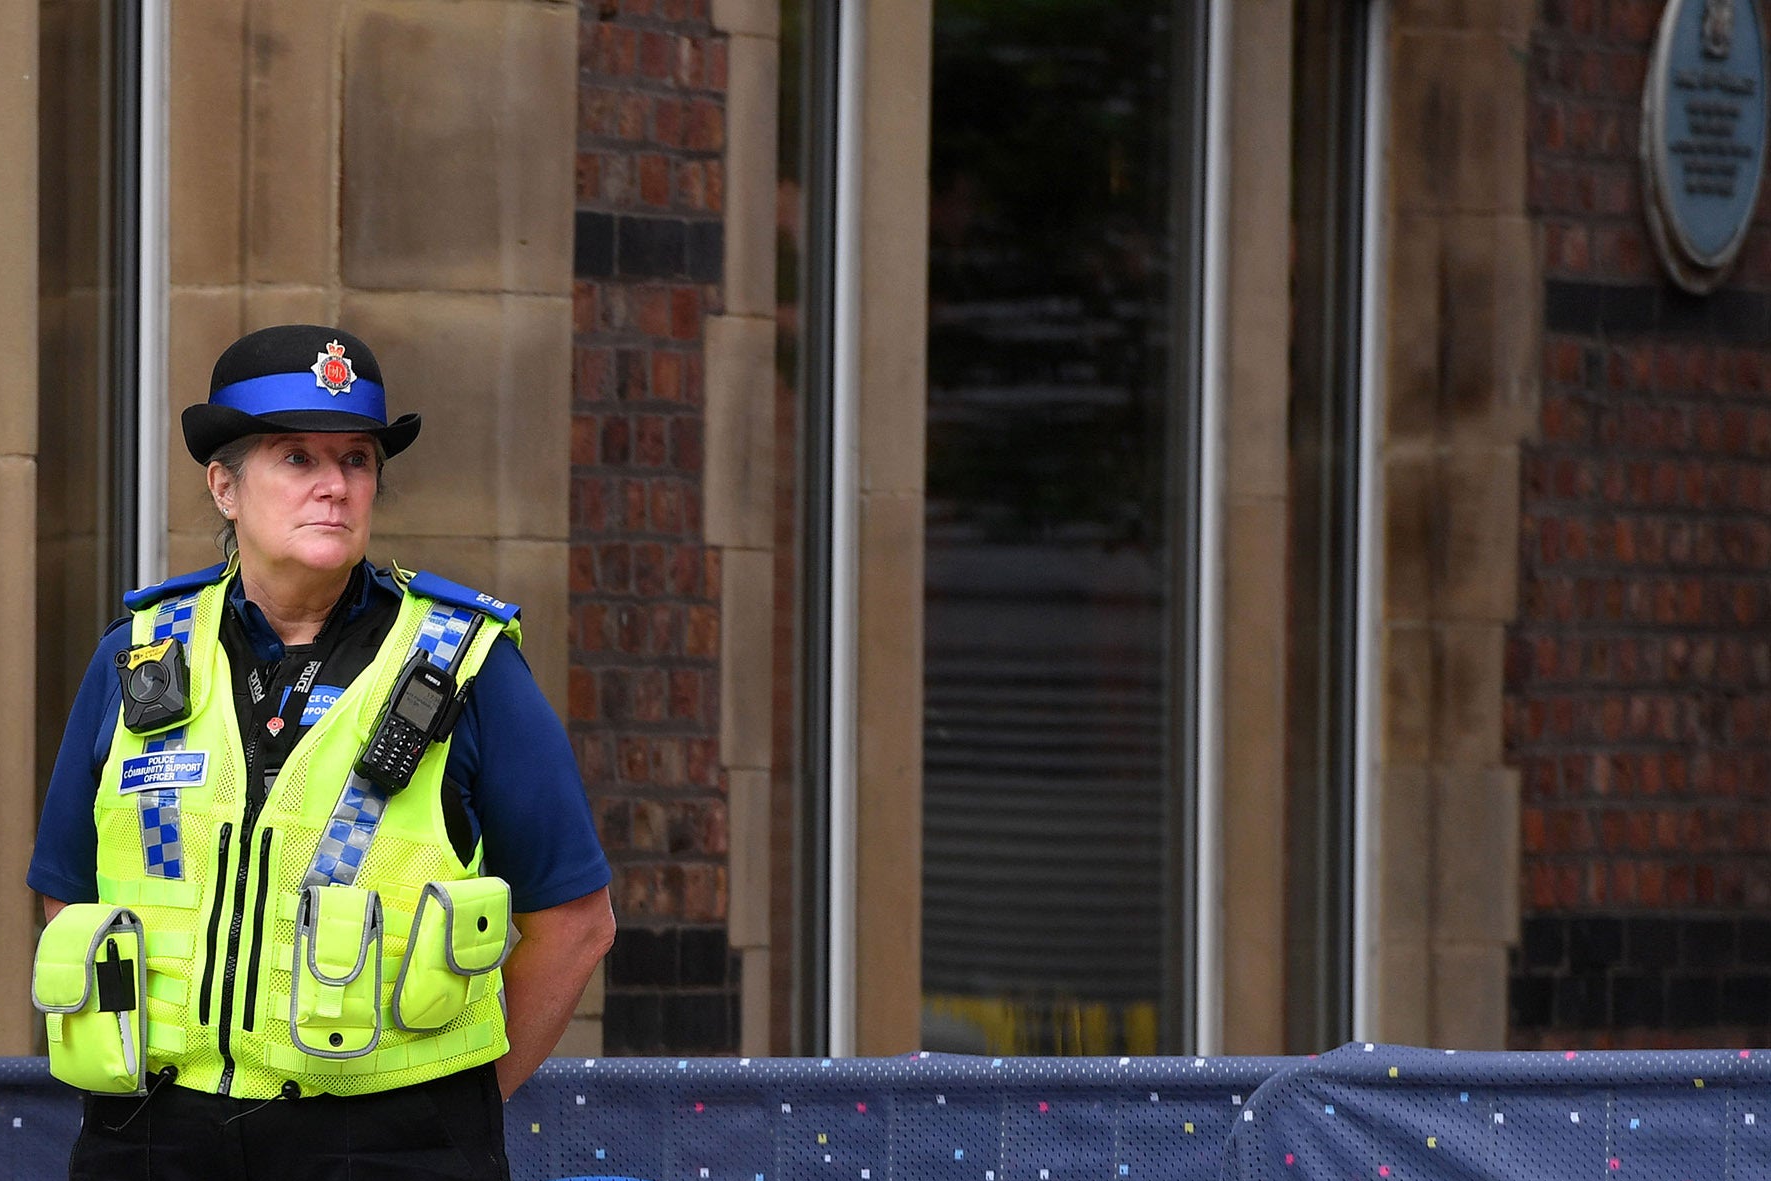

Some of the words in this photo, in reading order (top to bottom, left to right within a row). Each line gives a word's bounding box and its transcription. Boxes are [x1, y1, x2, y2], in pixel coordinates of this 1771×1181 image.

[248, 668, 266, 702] POLICE
[293, 660, 318, 693] POLICE
[148, 755, 176, 766] POLICE
[123, 765, 165, 779] COMMUNITY
[164, 762, 203, 773] SUPPORT
[144, 772, 176, 783] OFFICER
